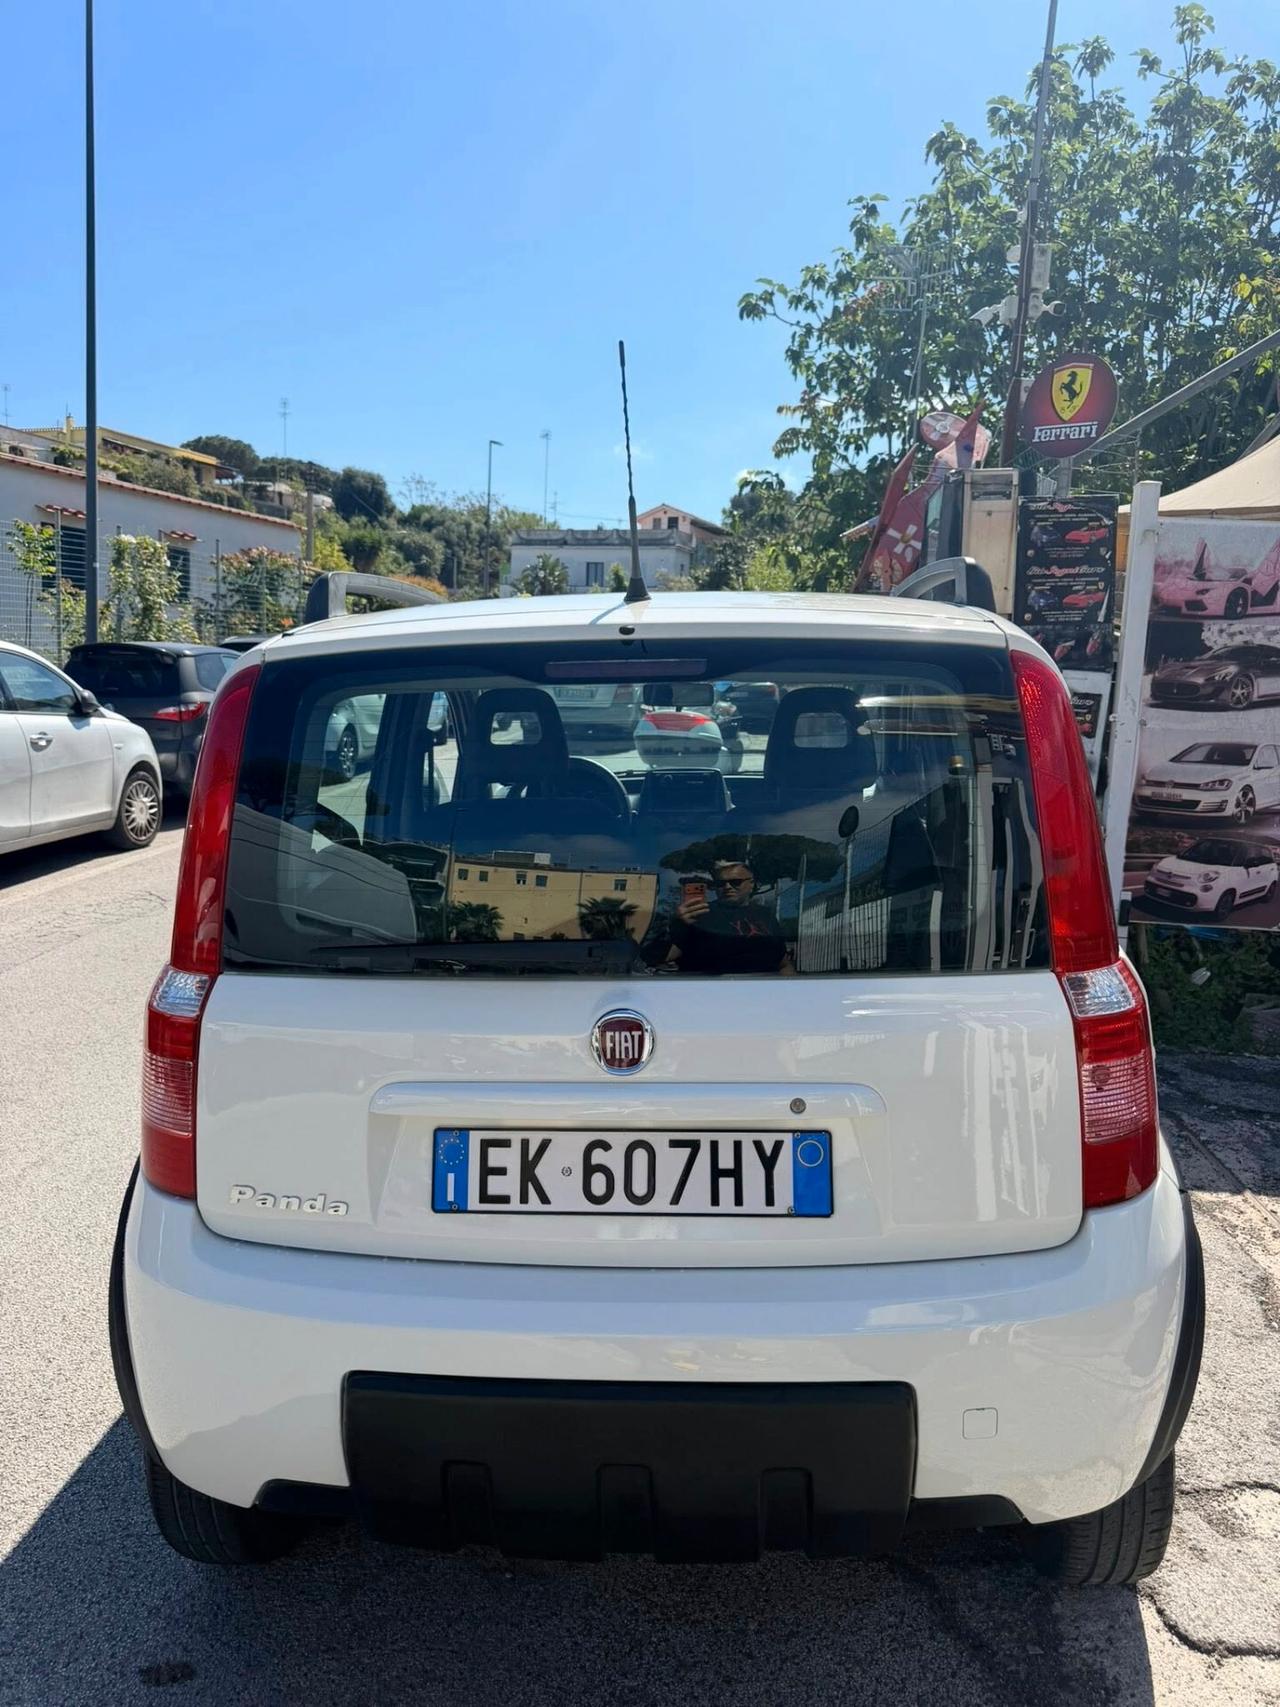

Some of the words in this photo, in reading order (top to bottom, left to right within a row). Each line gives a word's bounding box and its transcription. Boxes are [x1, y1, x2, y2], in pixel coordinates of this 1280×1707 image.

[1032, 421, 1098, 443] Ferrari
[605, 1030, 642, 1060] FIAT
[478, 1138, 553, 1205] EK
[582, 1138, 785, 1207] 607HY
[229, 1184, 350, 1217] Panda
